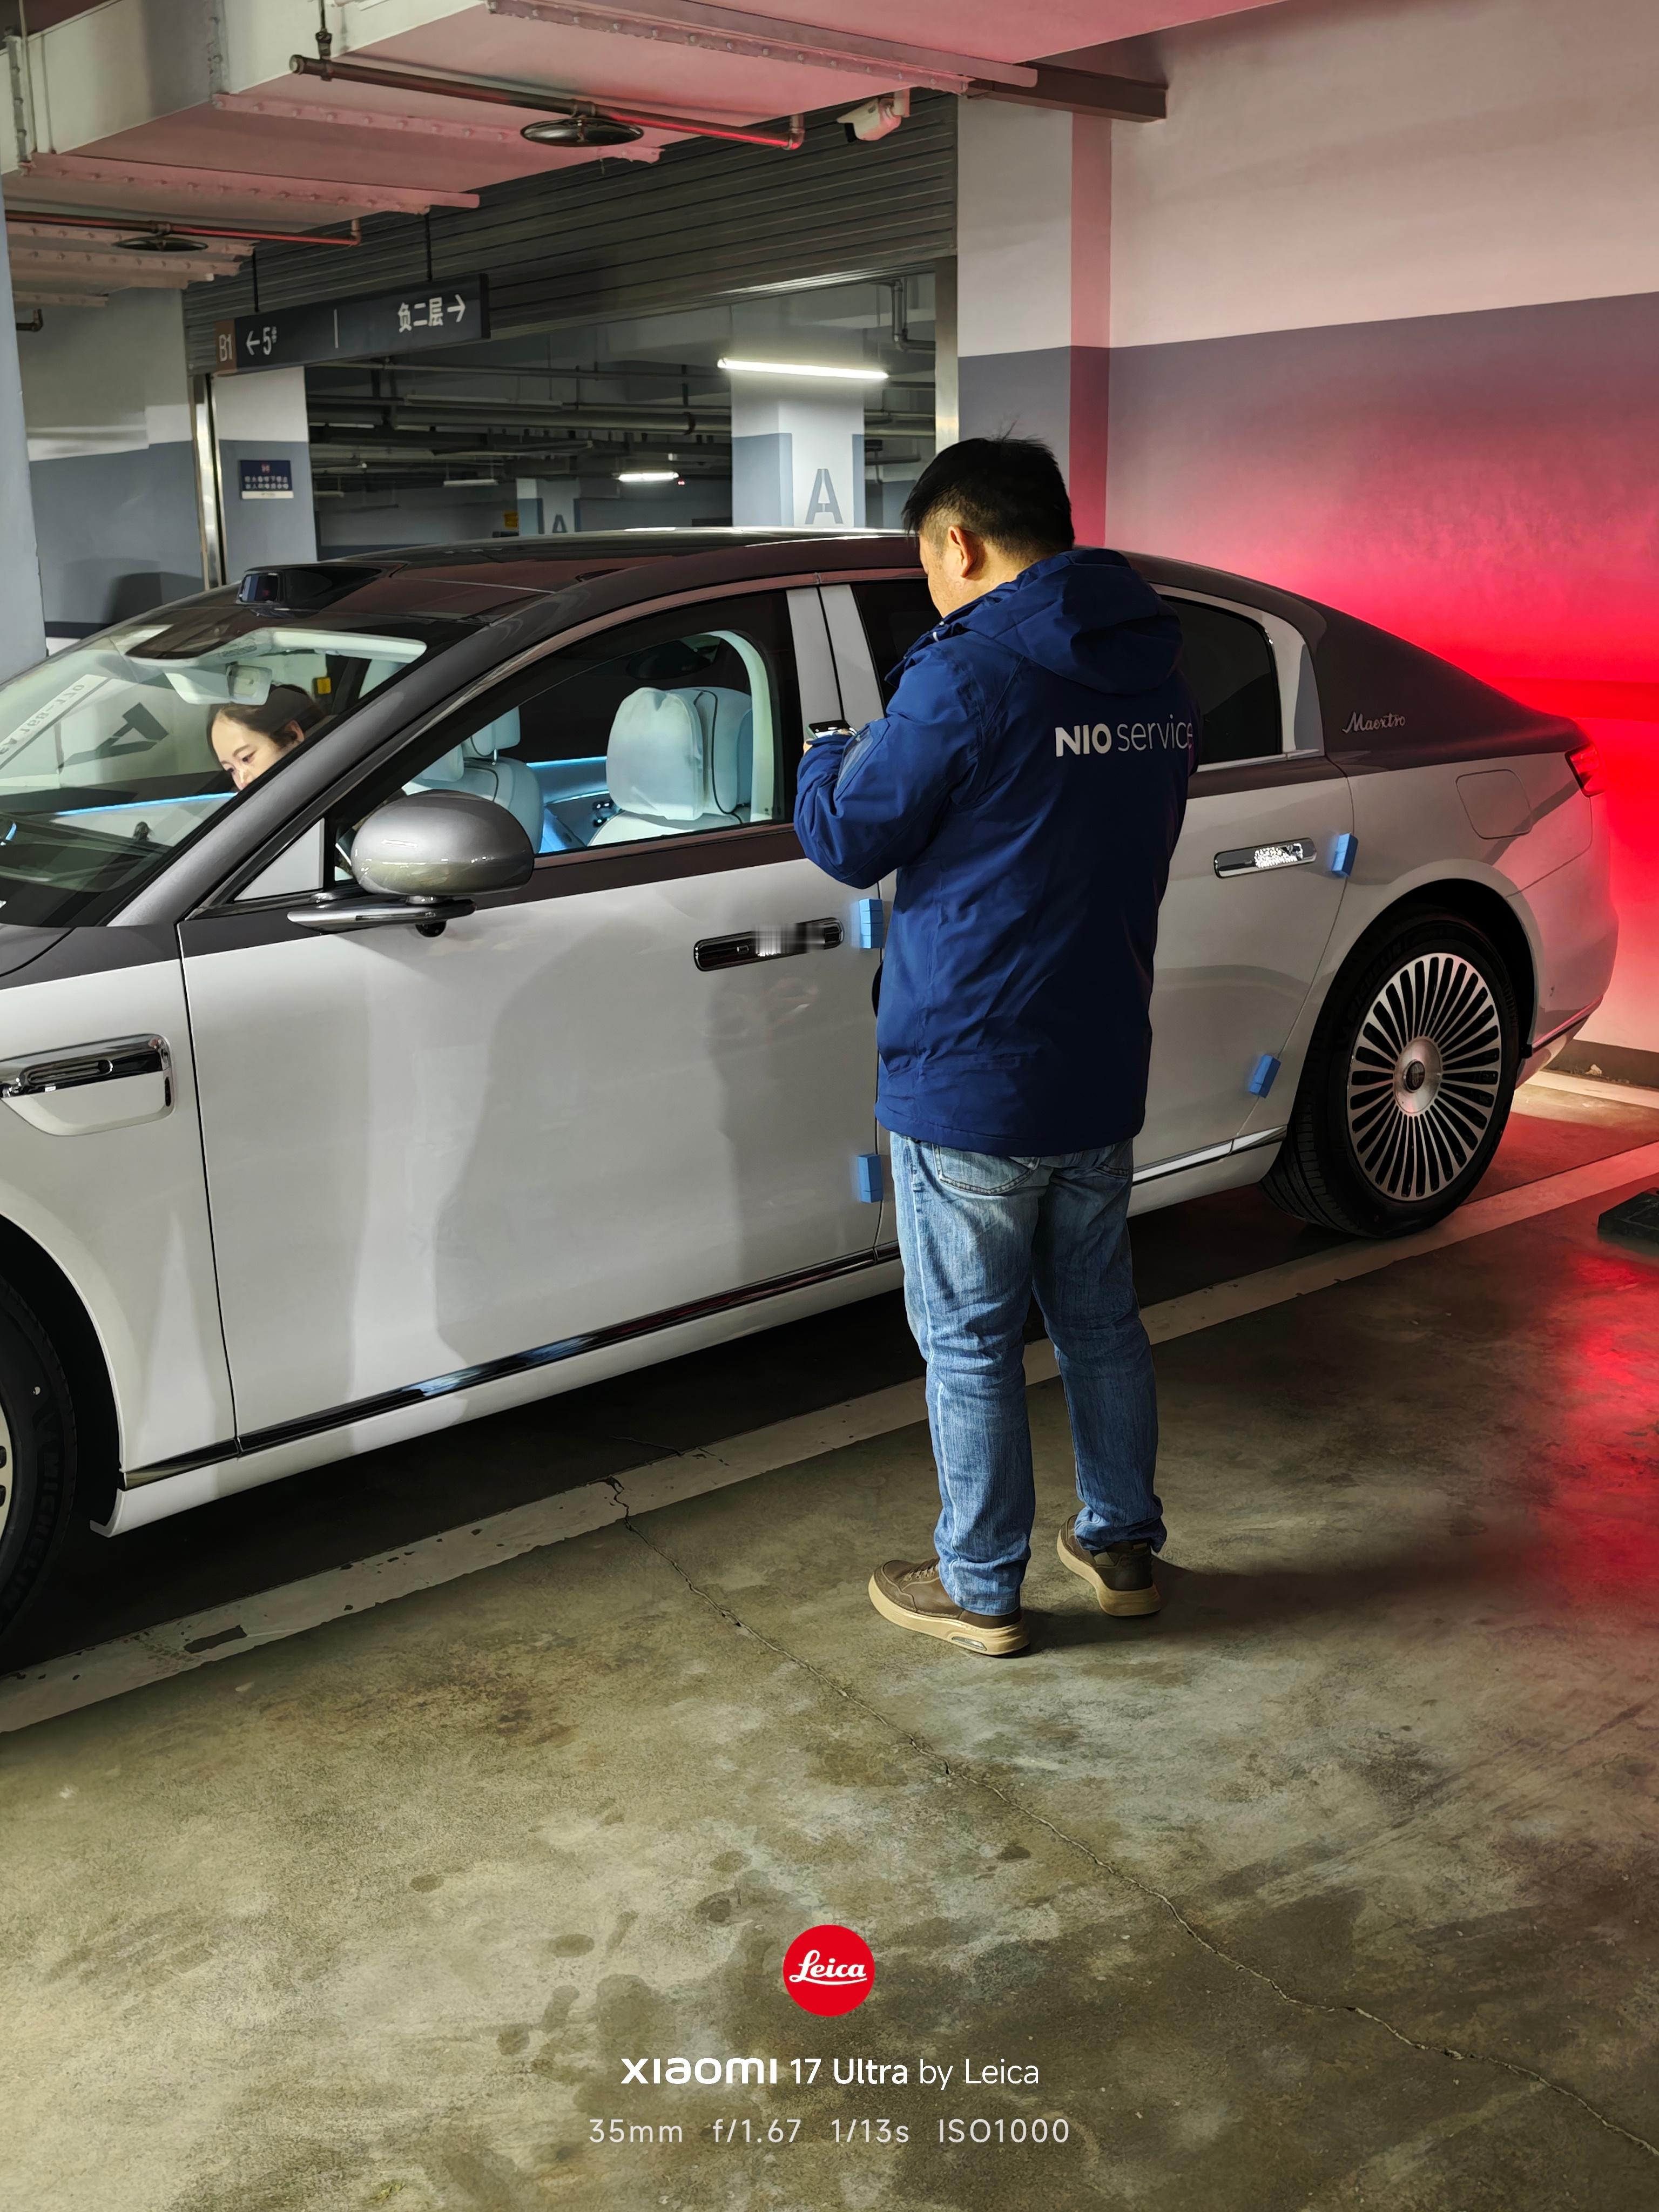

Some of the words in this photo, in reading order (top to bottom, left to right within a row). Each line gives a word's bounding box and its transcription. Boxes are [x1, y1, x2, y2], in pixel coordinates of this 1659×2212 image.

[397, 296, 443, 333] 负二层
[219, 334, 233, 361] B1
[804, 468, 844, 524] A
[1055, 723, 1112, 757] NIO
[1117, 713, 1193, 752] service
[1342, 711, 1406, 733] Maextro
